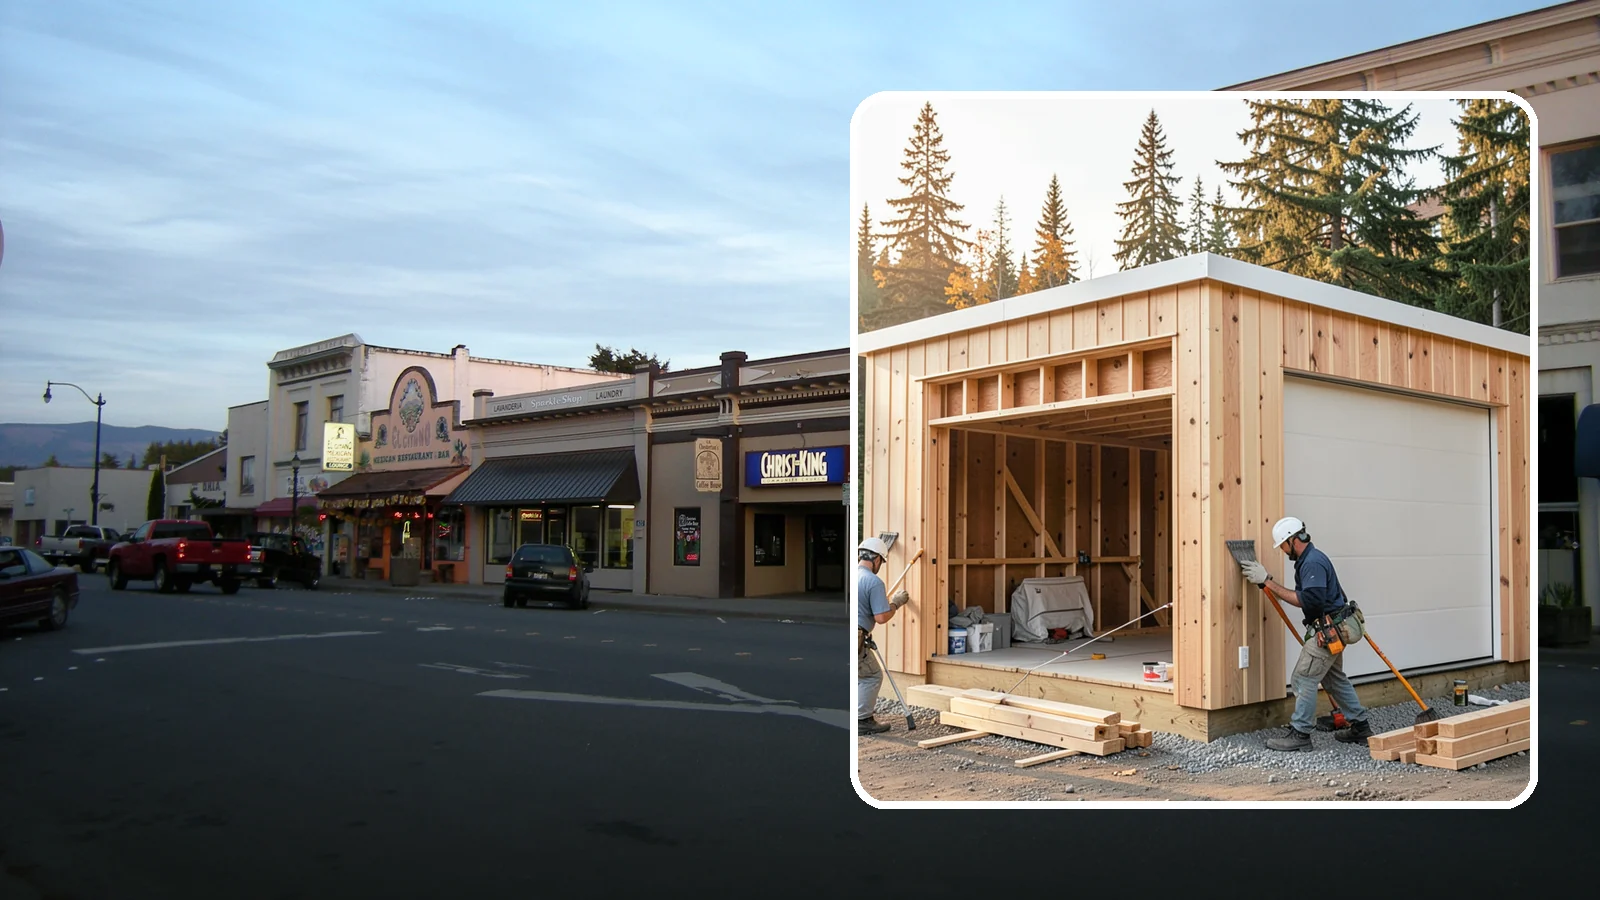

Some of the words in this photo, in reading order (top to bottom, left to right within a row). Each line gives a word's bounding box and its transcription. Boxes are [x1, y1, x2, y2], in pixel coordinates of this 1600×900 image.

[595, 388, 624, 400] LAUNDRY
[493, 402, 522, 413] LAVANDERIA
[530, 397, 561, 409] Sparkle
[562, 394, 582, 405] Shop
[373, 454, 396, 464] MEXICAN
[397, 451, 433, 463] RESTAURANT
[437, 450, 450, 459] BAR
[761, 451, 797, 478] CHRIST
[799, 449, 827, 476] KING
